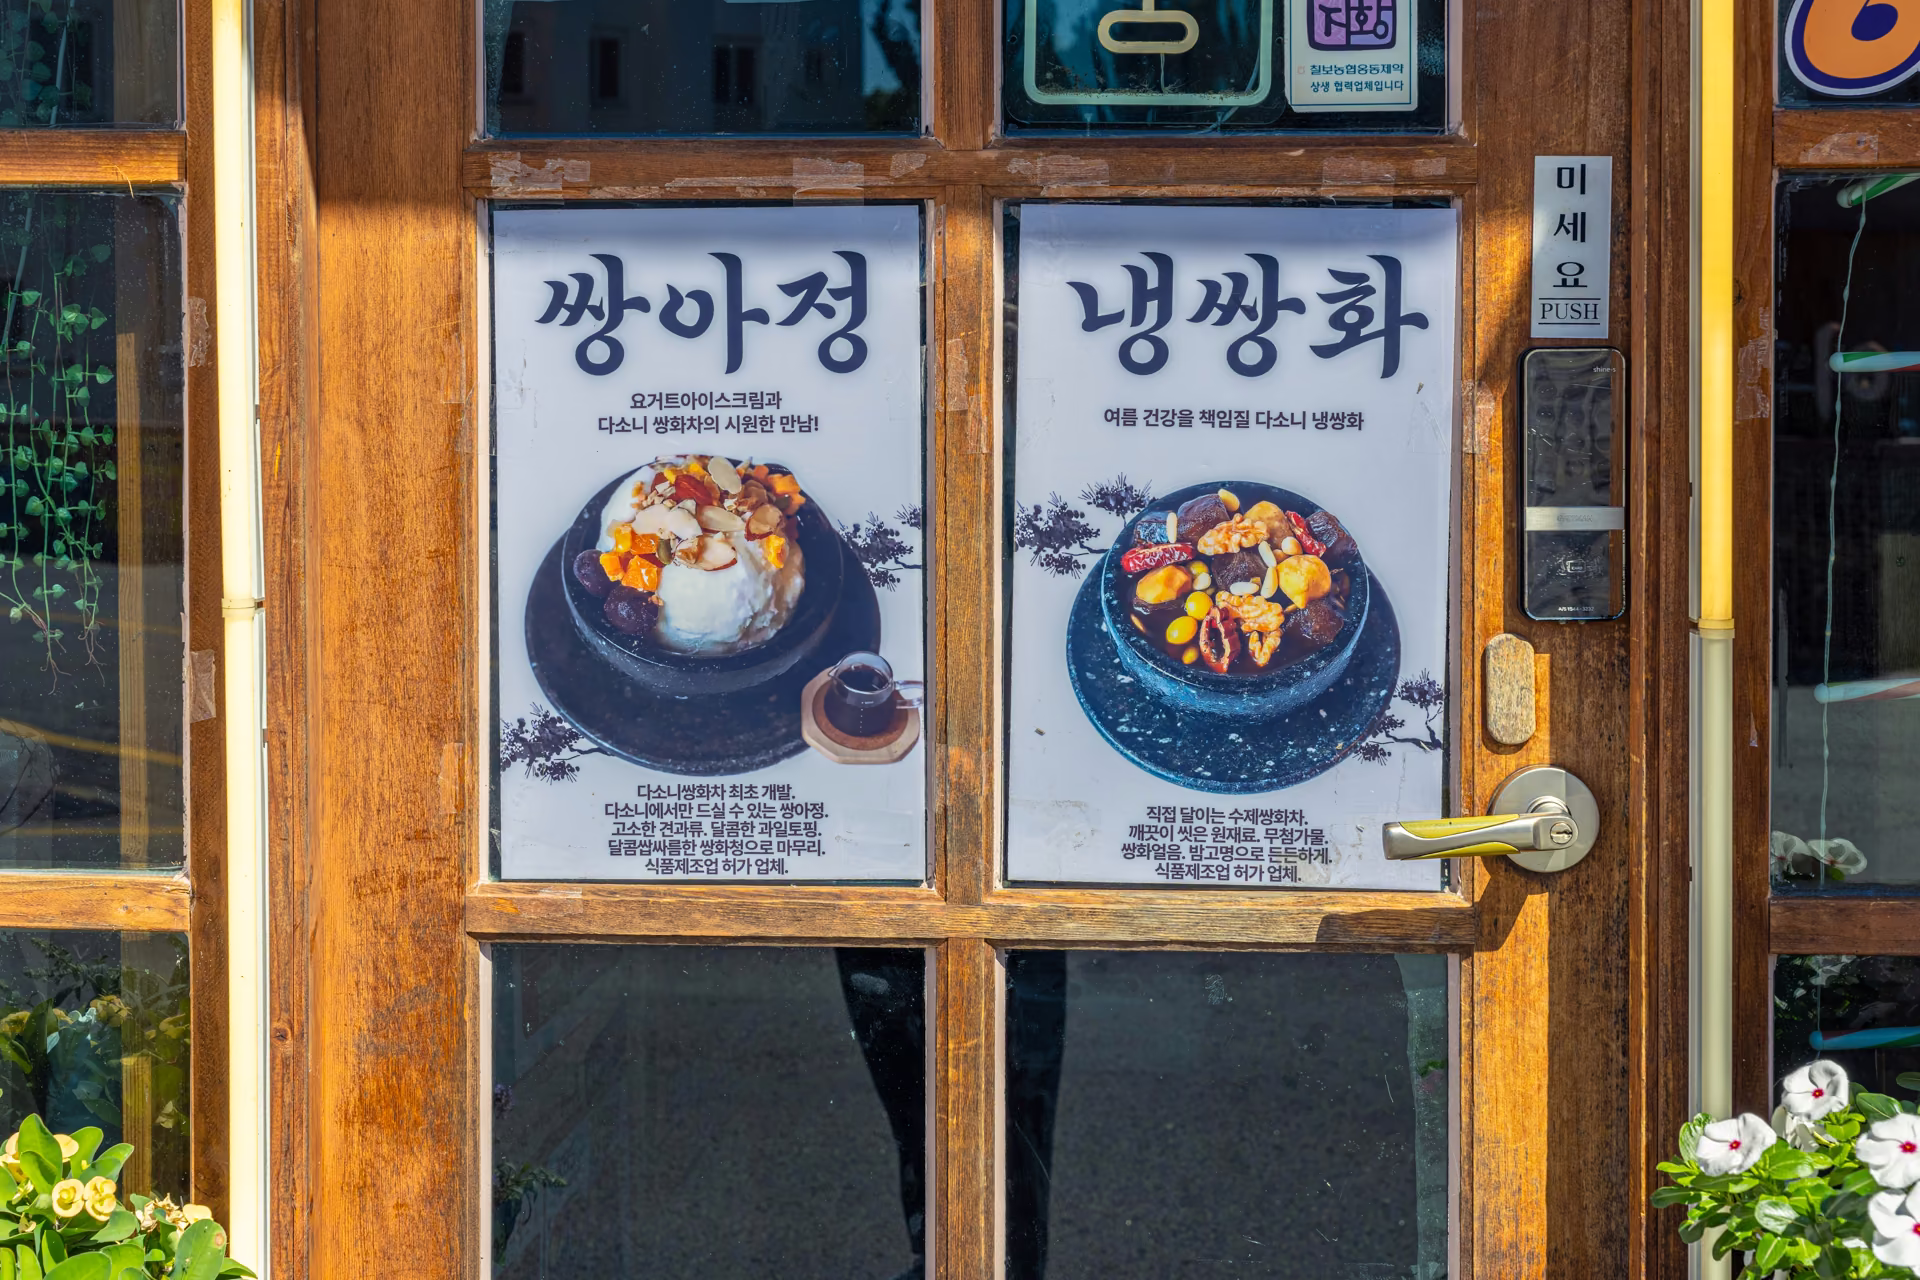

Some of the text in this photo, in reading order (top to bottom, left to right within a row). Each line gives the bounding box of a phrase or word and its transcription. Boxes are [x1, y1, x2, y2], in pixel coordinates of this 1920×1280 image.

[1310, 80, 1404, 93] 상생 협력업체입니다
[1553, 163, 1588, 288] 미세요
[534, 250, 868, 376] 쌍아정
[1066, 252, 1429, 379] 냉쌍화
[1540, 303, 1599, 320] PUSH
[630, 391, 782, 411] 요거트아이스크림과
[598, 415, 819, 435] 다소니 쌍화차의 시원한 만남!
[1104, 408, 1364, 431] 여름 건강을 책임질 다소니 냉쌍화
[637, 784, 796, 801] 다소니쌍화차 최초 개발.
[604, 802, 829, 819] 다소니에서만 드실 수 있는 쌍아정.
[1146, 806, 1309, 826] 직접 달이는 수제쌍화차.
[611, 821, 822, 838] 고소한 견과류. 달콤한 과일토핑.
[1128, 824, 1329, 846] 깨끗이 씻은 원재료. 무첨가물.
[608, 839, 826, 857] 달콤쌉싸름한 쌍화청으로 마무리.
[1121, 843, 1333, 865] 쌍화얼음. 밤고명으로 든든하게.
[645, 858, 789, 875] 식품제조업 허가 업체.
[1155, 862, 1302, 883] 식품제조업 허가 업체.
